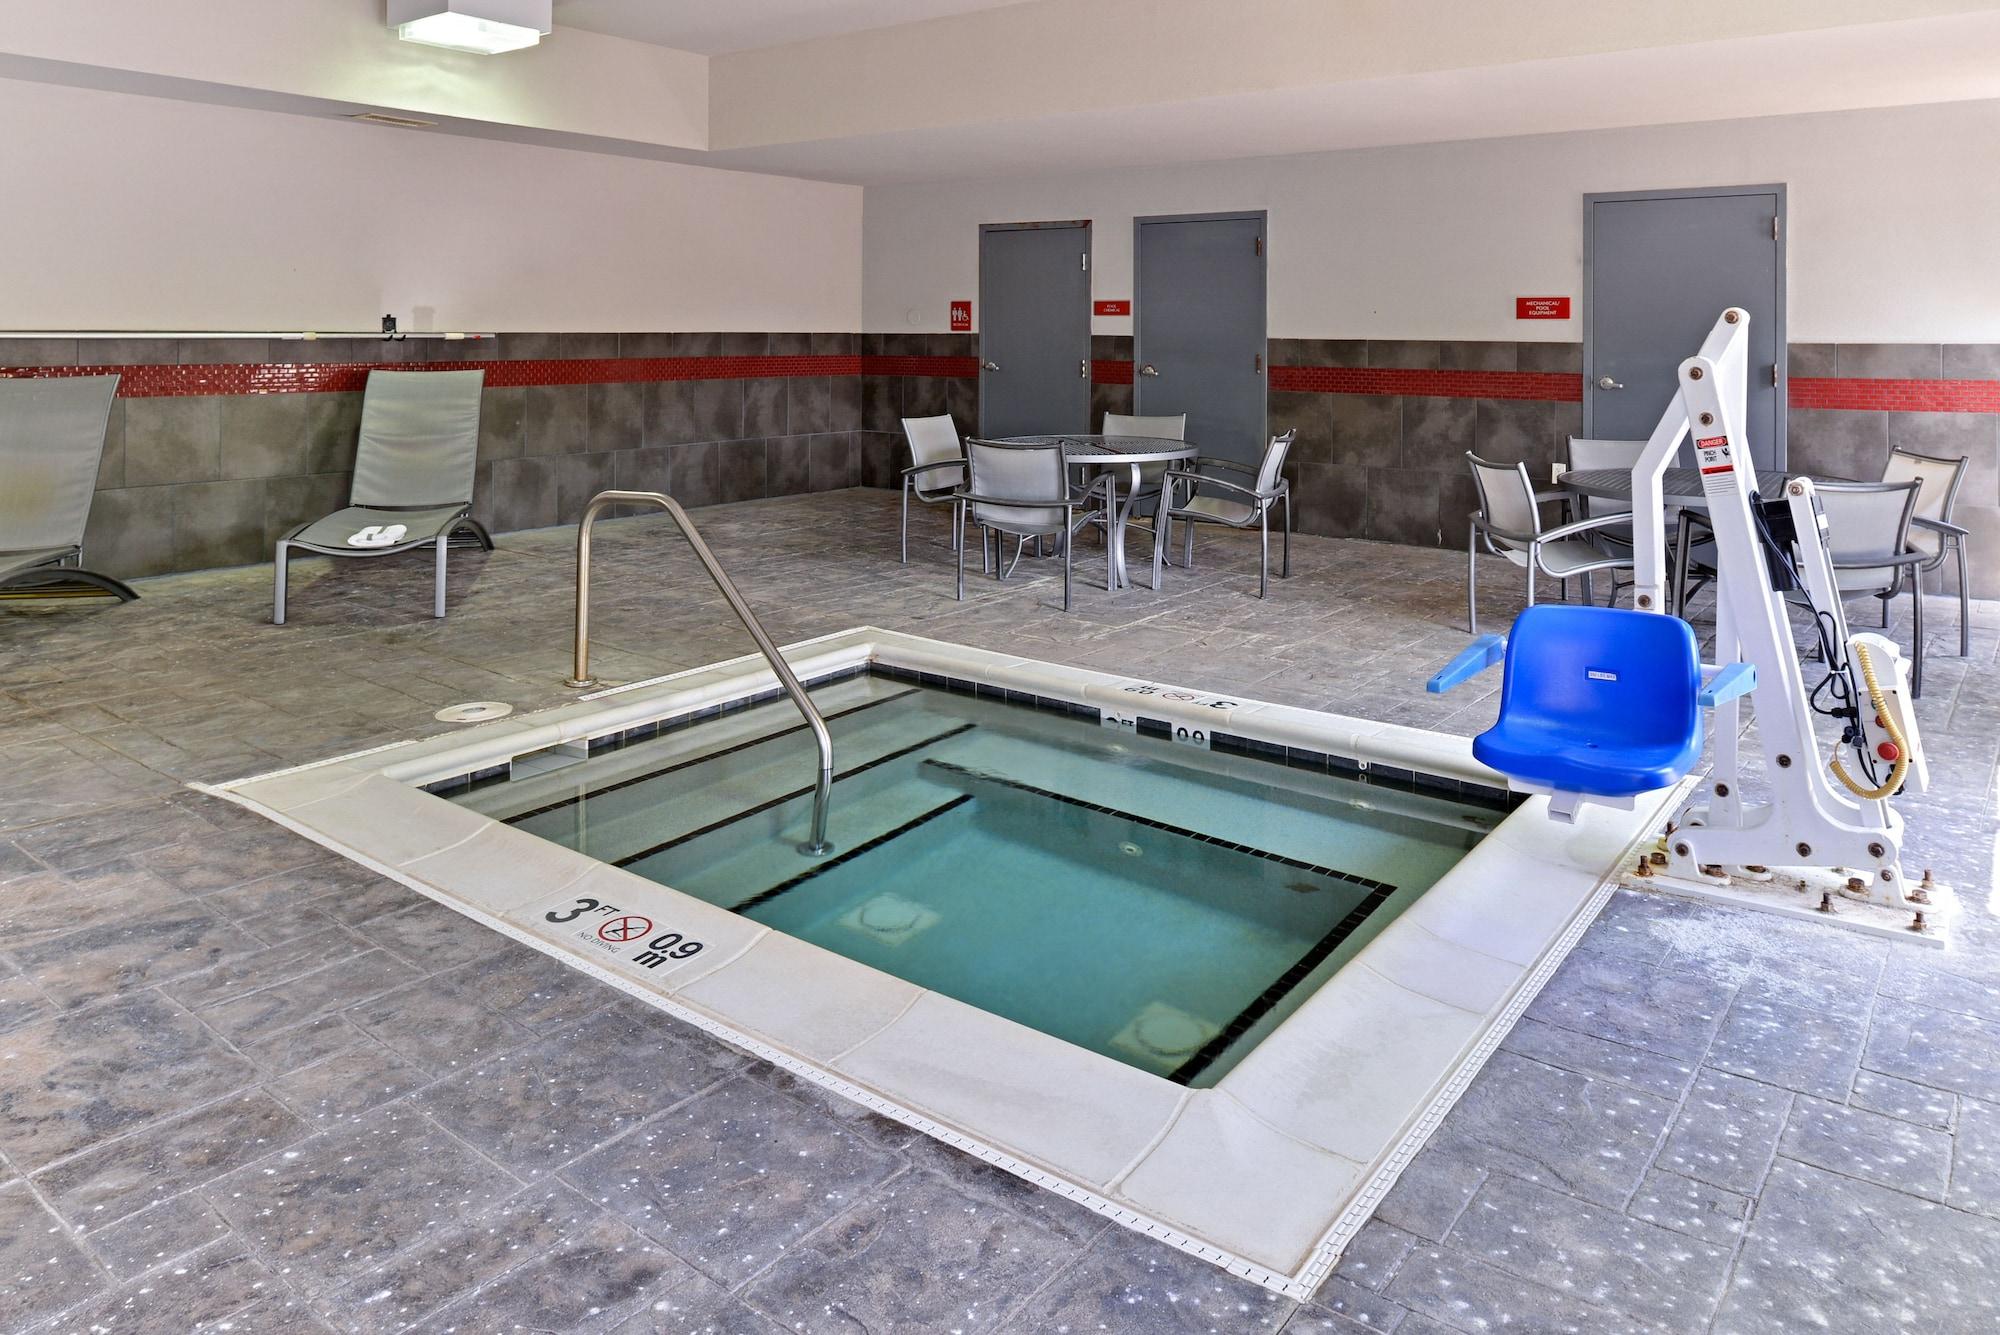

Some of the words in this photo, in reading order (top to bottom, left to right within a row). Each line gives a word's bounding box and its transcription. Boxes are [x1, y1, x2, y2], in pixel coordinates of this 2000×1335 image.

[1700, 438, 1724, 447] DANGER
[1210, 701, 1238, 710] 3
[545, 898, 600, 923] 3
[593, 905, 621, 917] FT
[577, 931, 591, 940] NO
[590, 936, 621, 954] DIVING
[648, 933, 704, 960] 0.9
[632, 950, 668, 969] m
